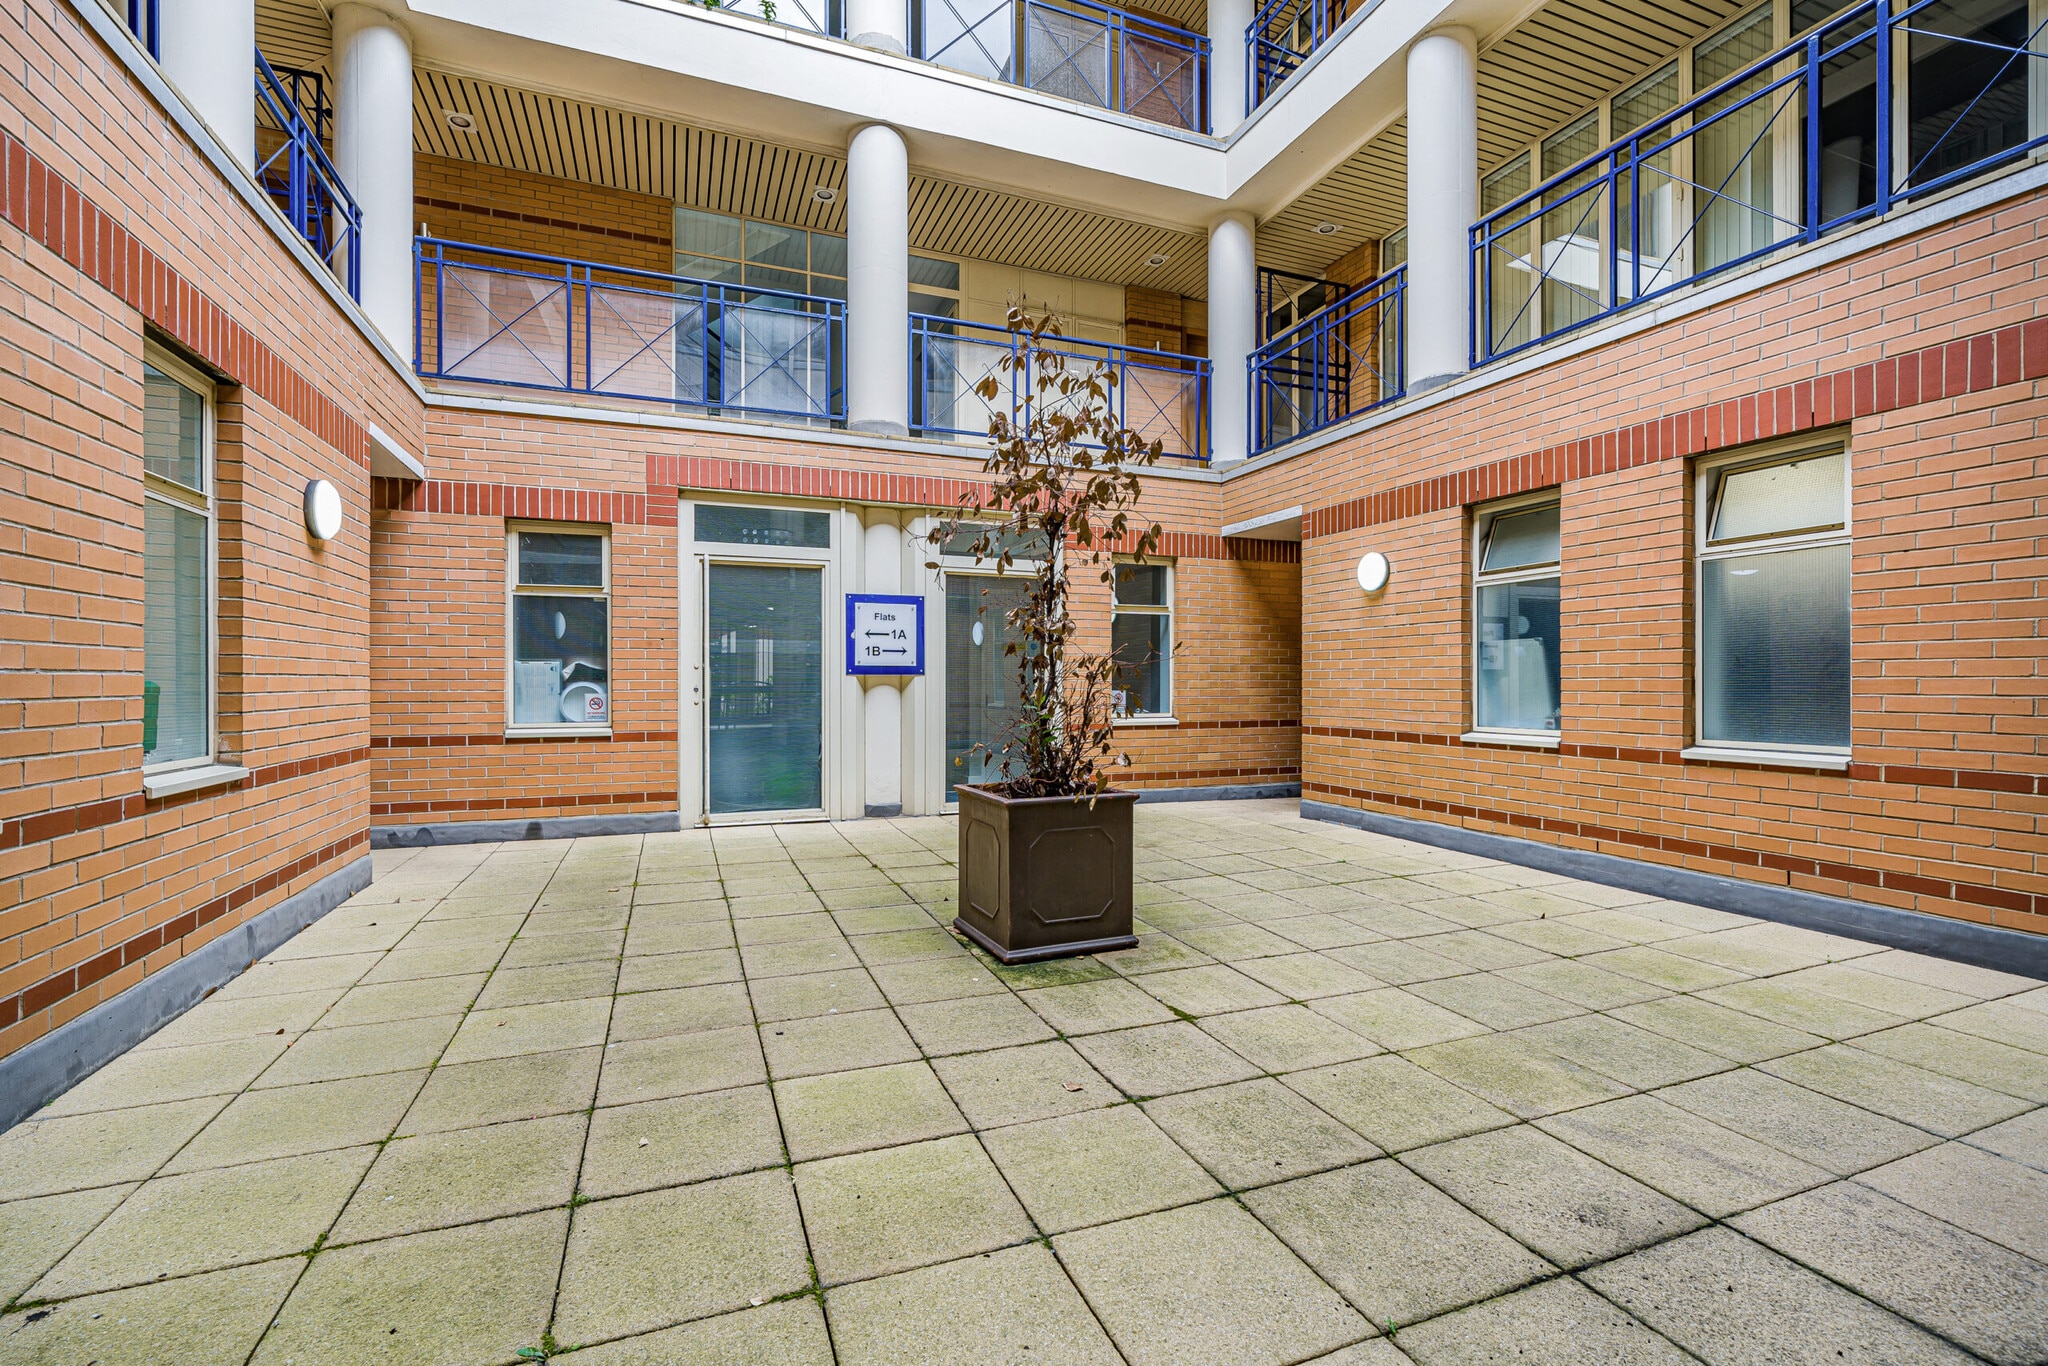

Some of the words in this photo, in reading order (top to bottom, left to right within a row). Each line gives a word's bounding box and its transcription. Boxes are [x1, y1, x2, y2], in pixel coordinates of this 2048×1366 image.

[874, 612, 896, 621] Flats
[891, 629, 907, 640] 1A
[865, 646, 881, 656] 1B
